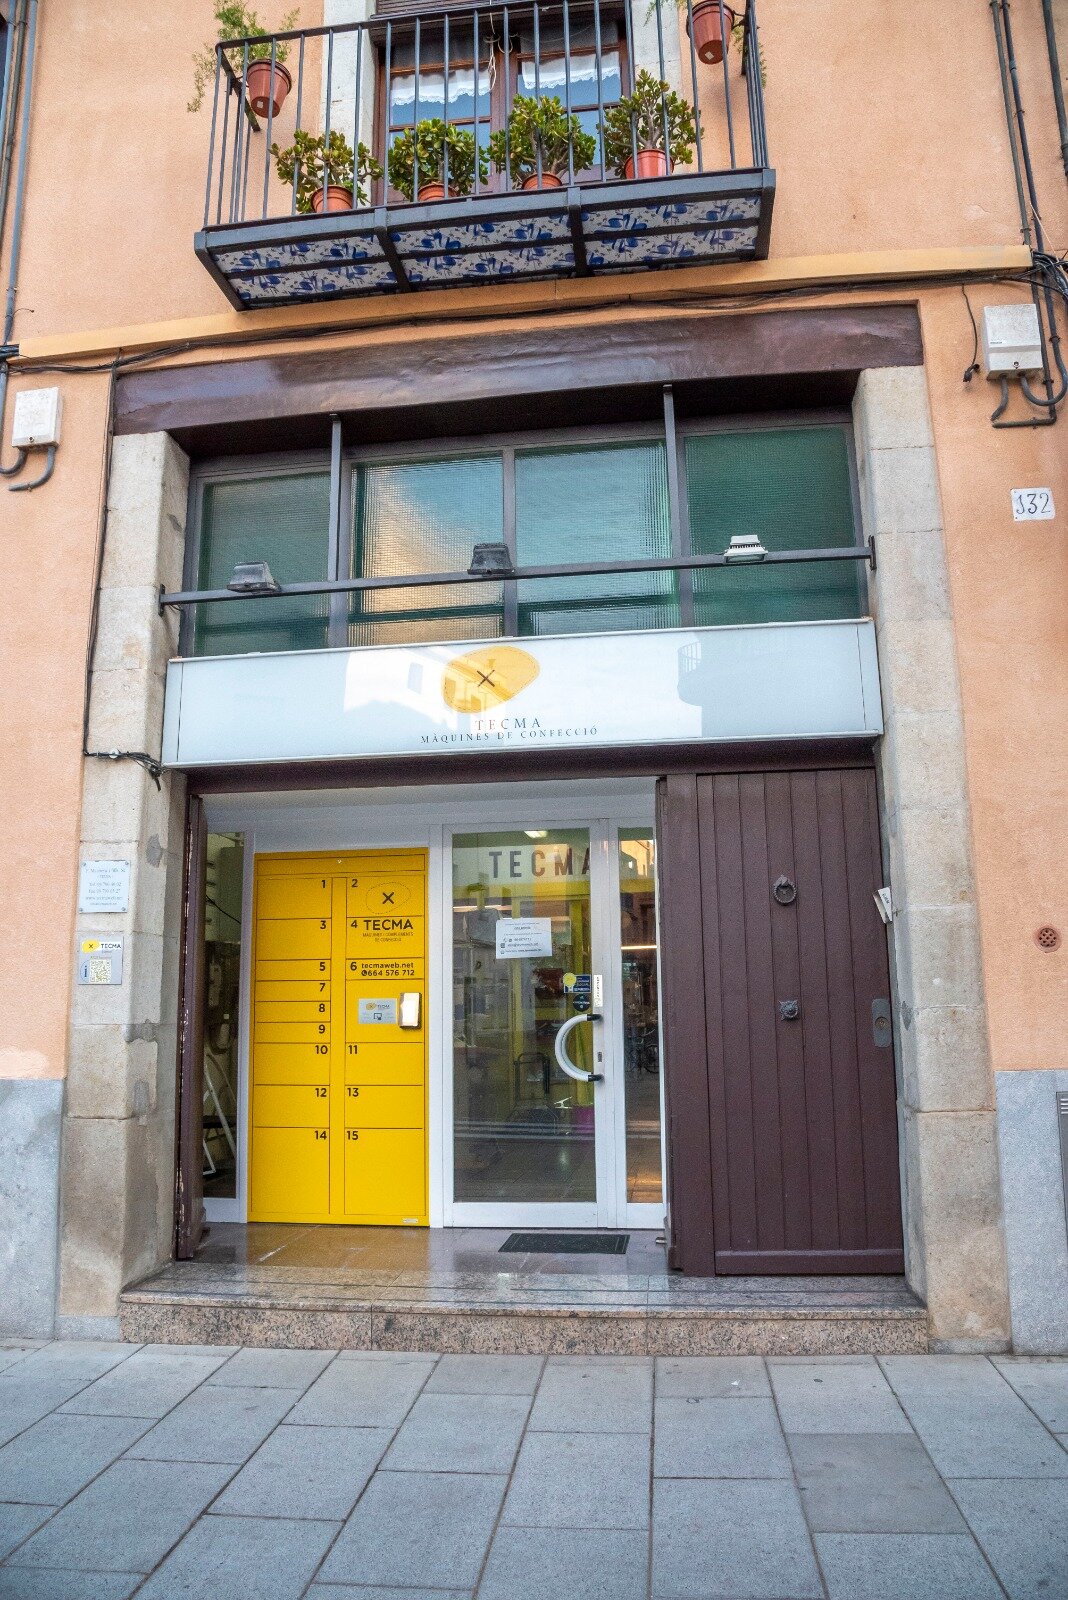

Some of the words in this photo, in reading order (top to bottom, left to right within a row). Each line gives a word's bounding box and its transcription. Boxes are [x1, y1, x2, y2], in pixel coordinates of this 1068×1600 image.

[1016, 492, 1051, 515] 132
[474, 717, 541, 731] TECMA
[420, 732, 489, 744] MÀQUINES
[497, 731, 513, 740] DE
[520, 725, 598, 739] CONFECCIÓ
[322, 880, 327, 889] 1
[351, 879, 358, 888] 2
[320, 920, 327, 930] 3
[350, 920, 358, 929] 4
[363, 919, 413, 931] TECMA
[319, 962, 326, 971] 5
[350, 962, 357, 971] 6
[361, 961, 414, 969] tecmaweb.net
[319, 983, 326, 992] 7
[318, 1003, 326, 1013] 8
[318, 1024, 326, 1034] 9
[315, 1045, 328, 1055] 10
[348, 1045, 358, 1055] 11
[315, 1088, 327, 1098] 12
[347, 1087, 359, 1097] 13
[314, 1131, 327, 1141] 14
[347, 1131, 358, 1141] 15
